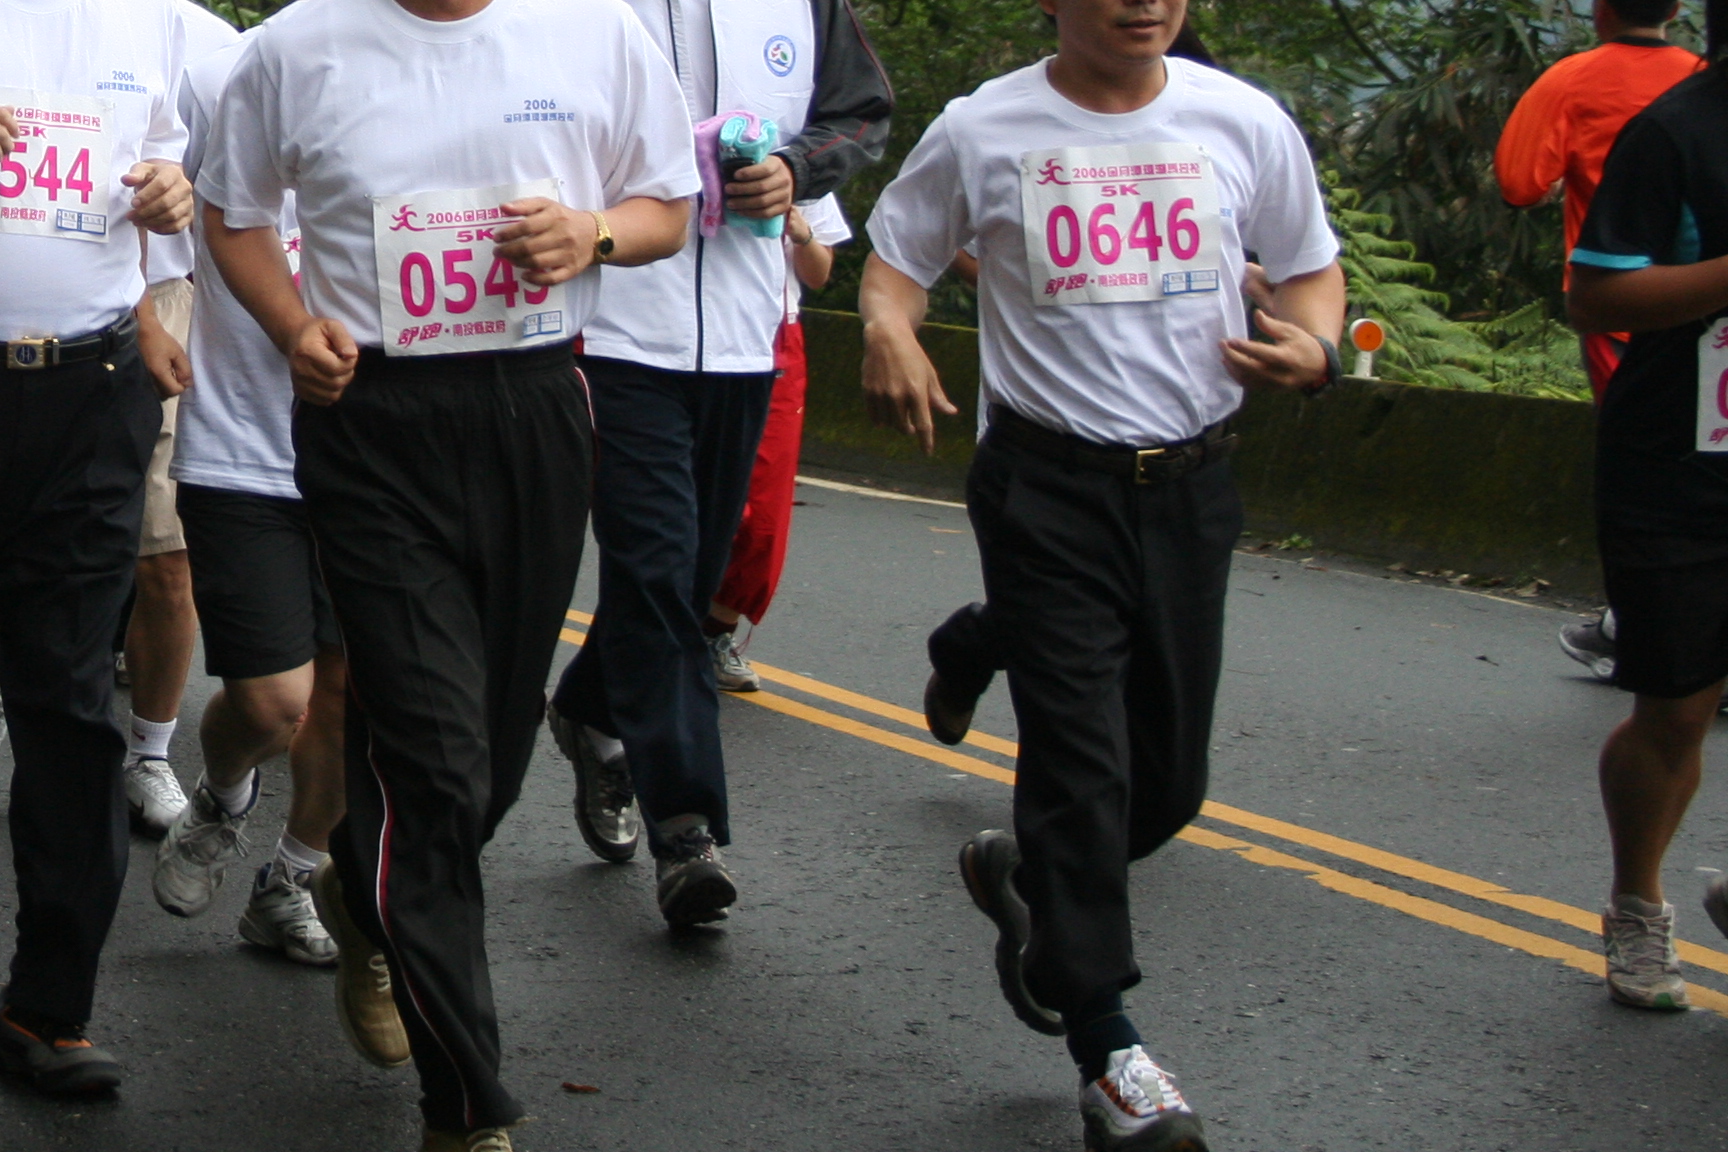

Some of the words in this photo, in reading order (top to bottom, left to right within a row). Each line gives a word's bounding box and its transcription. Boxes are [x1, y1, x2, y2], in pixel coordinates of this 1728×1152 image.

[112, 70, 135, 82] 2006
[524, 99, 556, 110] 2006
[17, 125, 47, 139] 5K
[1100, 183, 1140, 197] 5K
[456, 228, 495, 243] 5K
[1046, 198, 1200, 268] 0646
